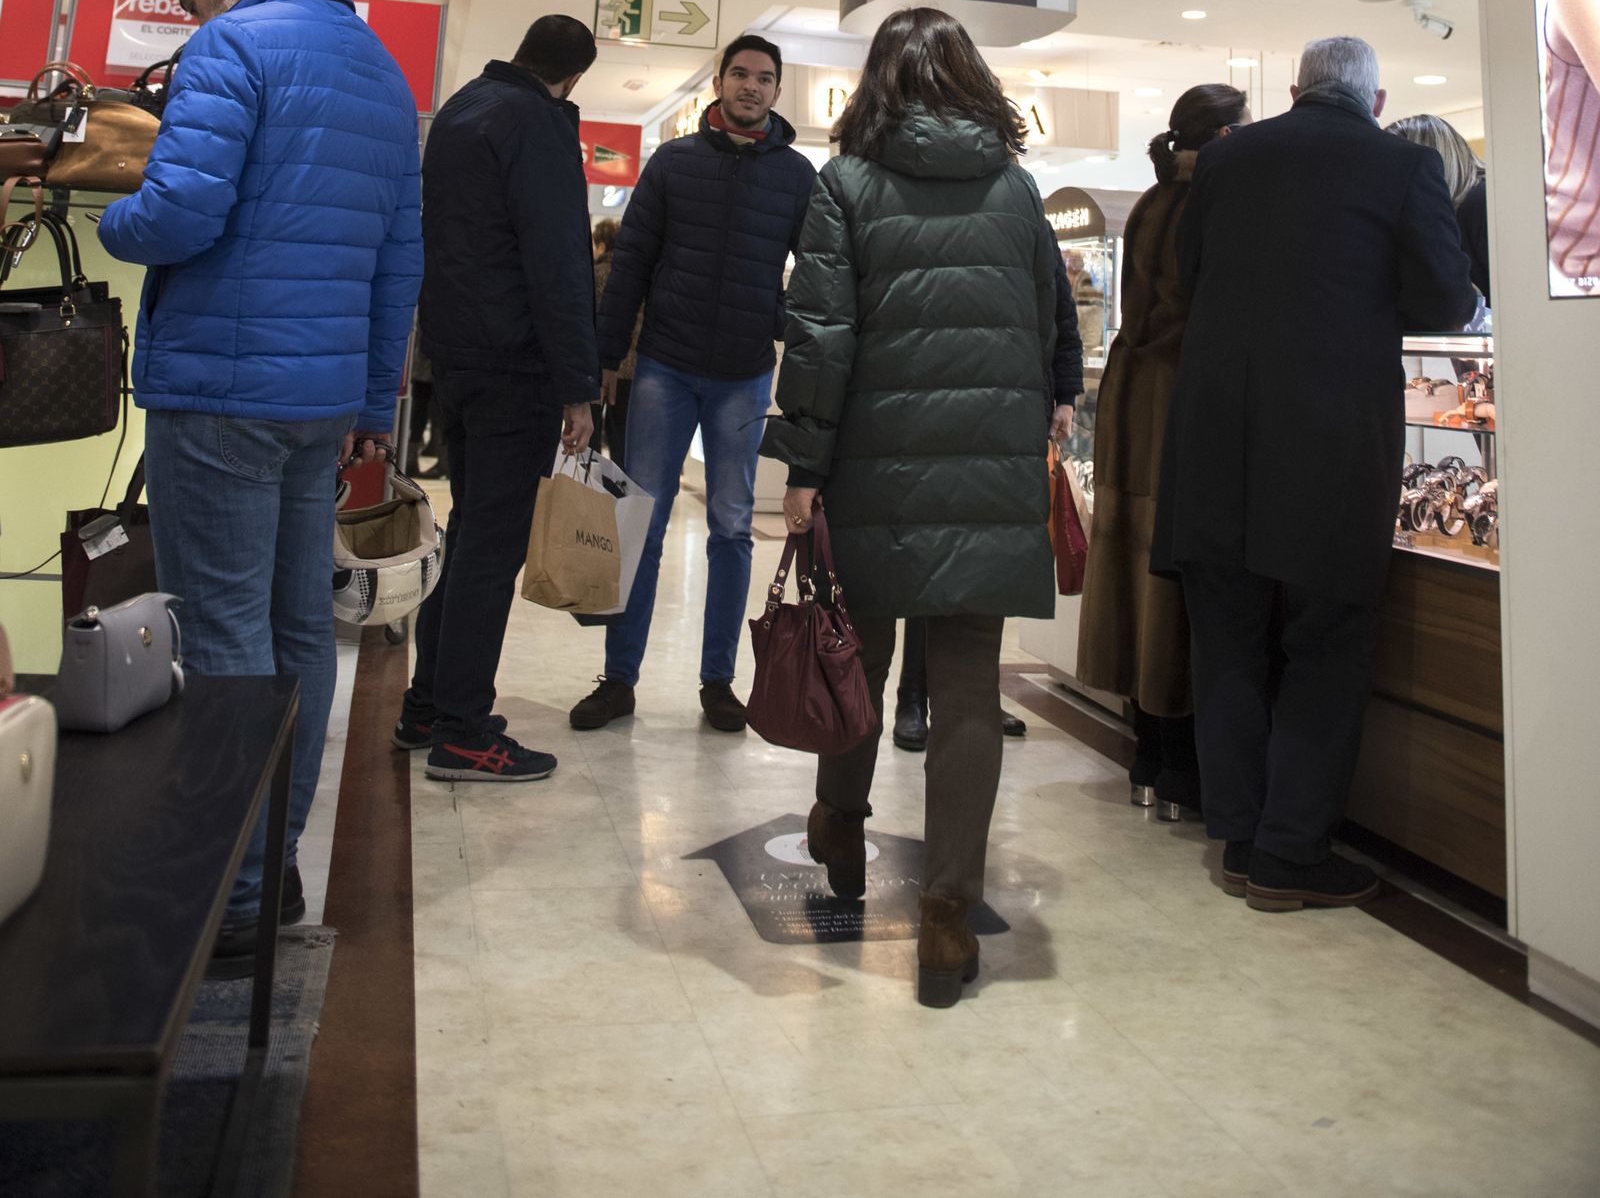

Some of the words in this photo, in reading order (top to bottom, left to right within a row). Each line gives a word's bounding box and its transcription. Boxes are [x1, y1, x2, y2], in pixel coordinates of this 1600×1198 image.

[141, 24, 153, 33] EL
[156, 25, 191, 37] CORTE
[575, 528, 614, 553] MANGO
